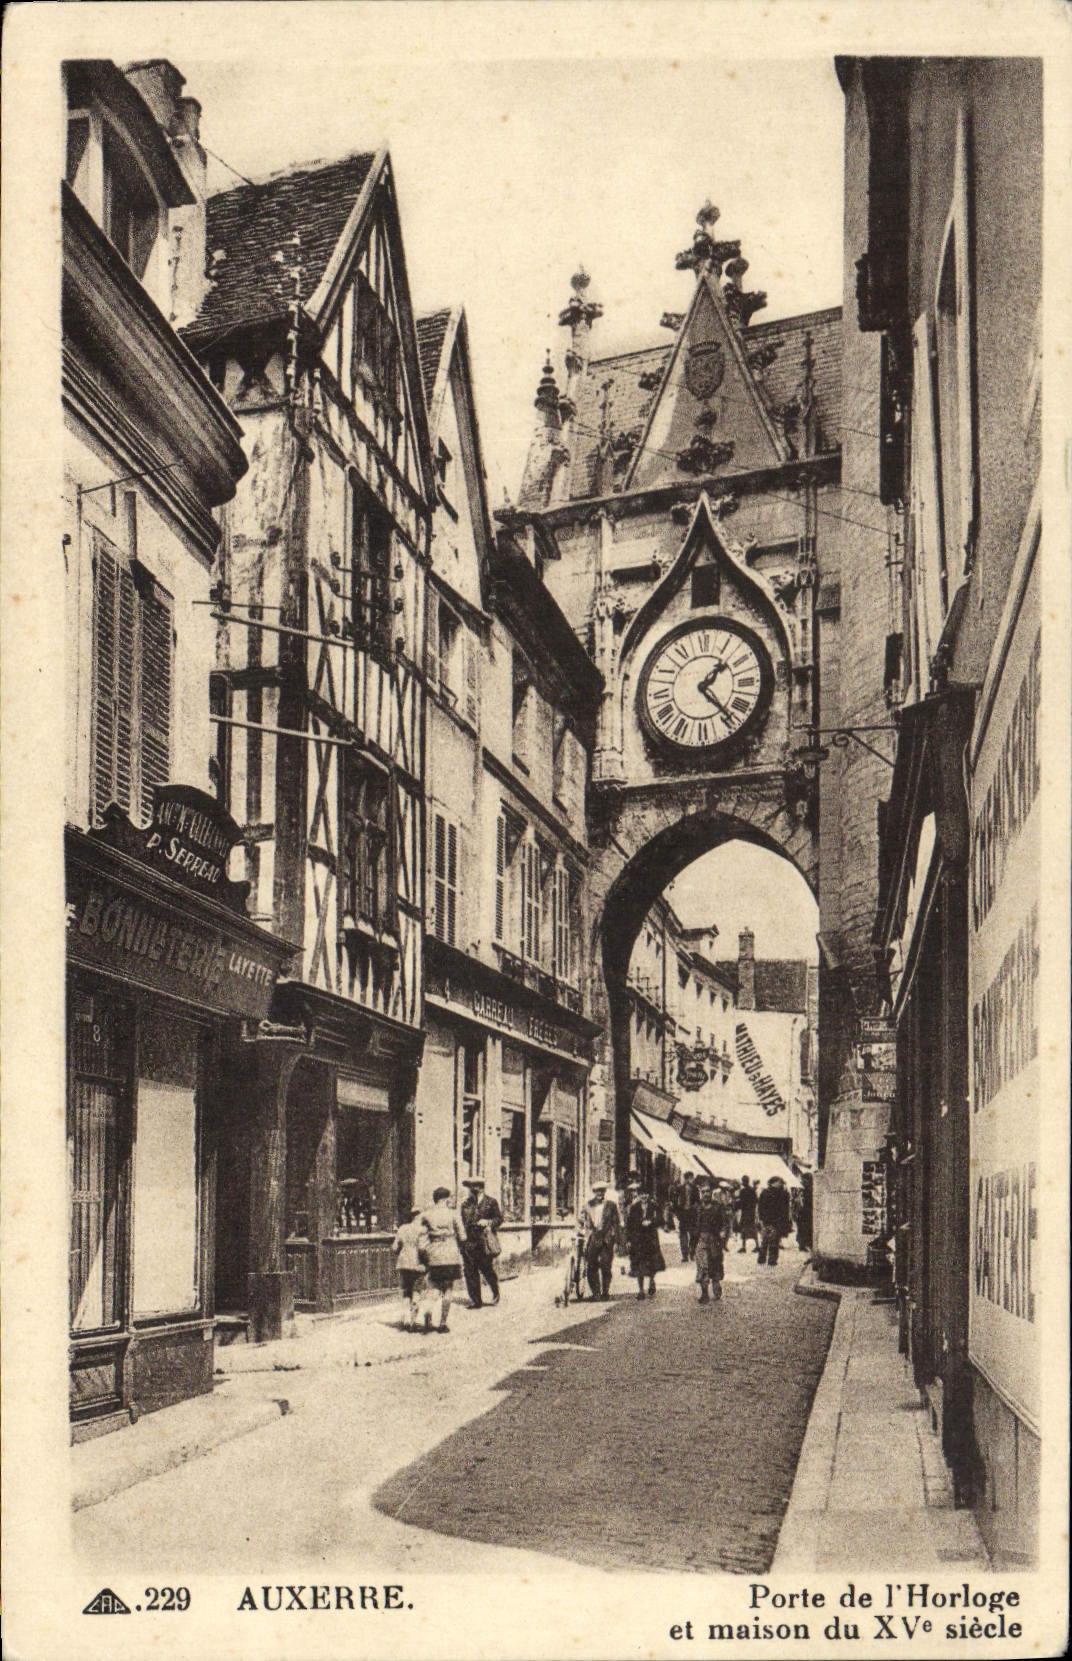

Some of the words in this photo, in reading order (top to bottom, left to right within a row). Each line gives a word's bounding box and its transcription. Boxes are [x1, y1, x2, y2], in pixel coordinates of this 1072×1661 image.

[228, 952, 273, 987] LAYETTE
[93, 1023, 101, 1042] 8
[735, 1022, 764, 1075] MATHIEU
